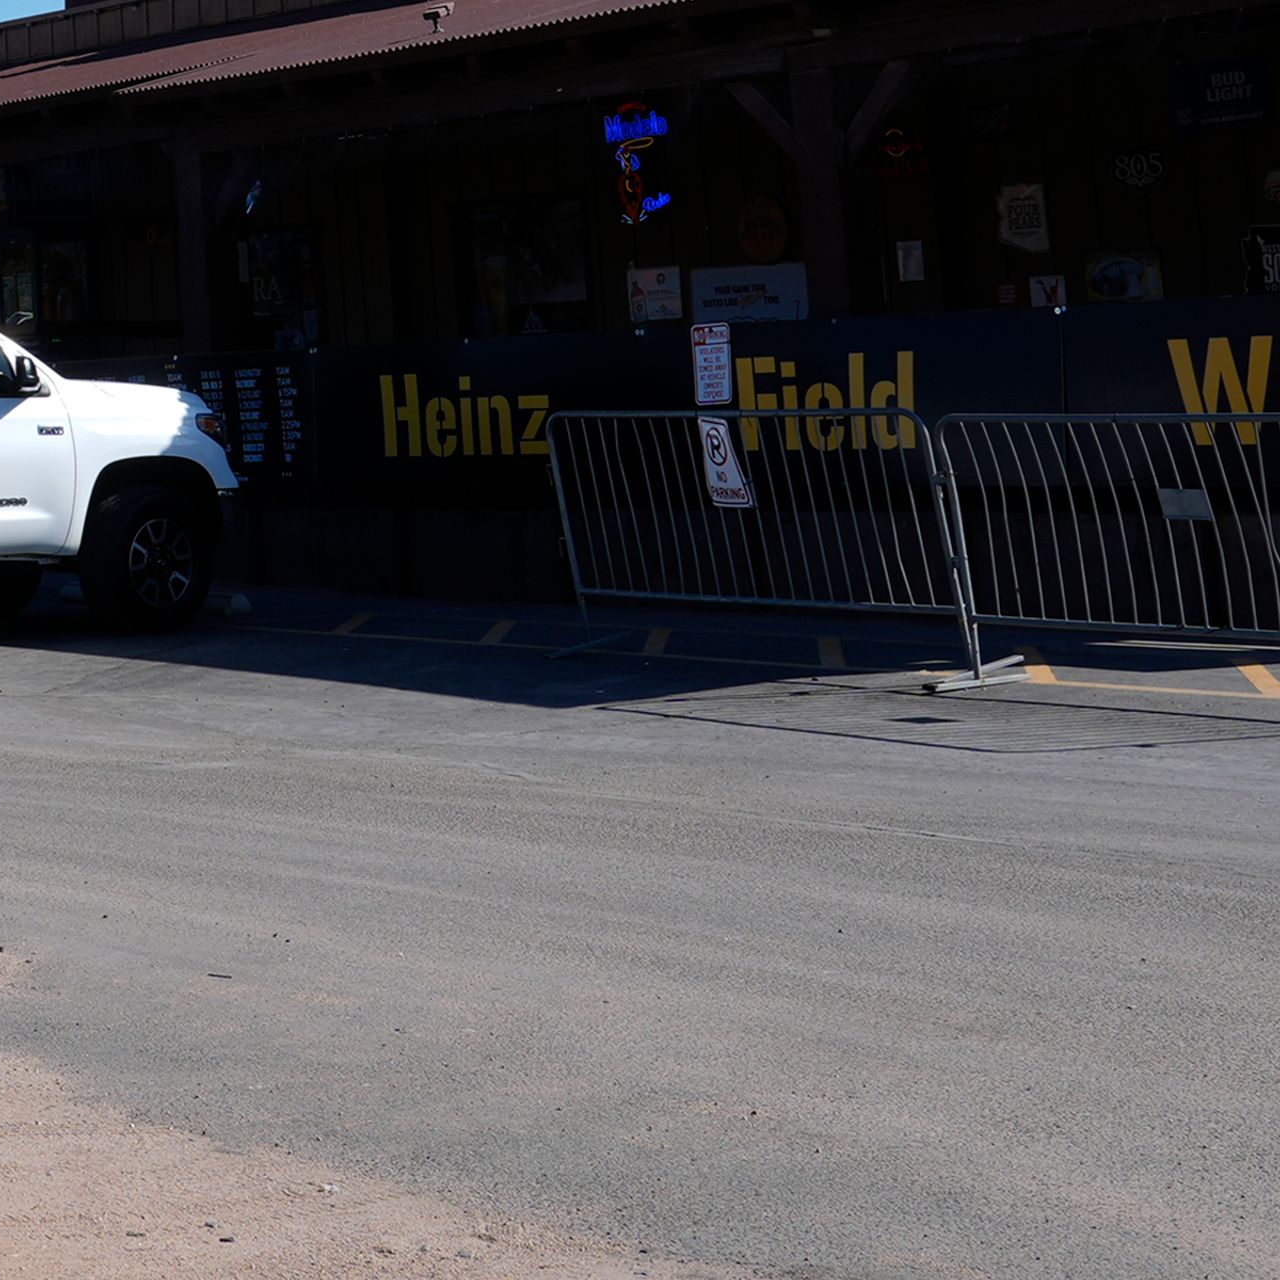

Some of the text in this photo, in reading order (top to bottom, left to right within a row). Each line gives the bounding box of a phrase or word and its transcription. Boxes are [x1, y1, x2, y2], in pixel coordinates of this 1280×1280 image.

[1210, 69, 1246, 87] BUD
[1206, 84, 1255, 102] LIGHT
[1113, 152, 1164, 180] 805
[736, 350, 916, 451] Field
[378, 373, 550, 458] Heinz
[715, 471, 728, 483] NO
[711, 486, 747, 500] PARKING
